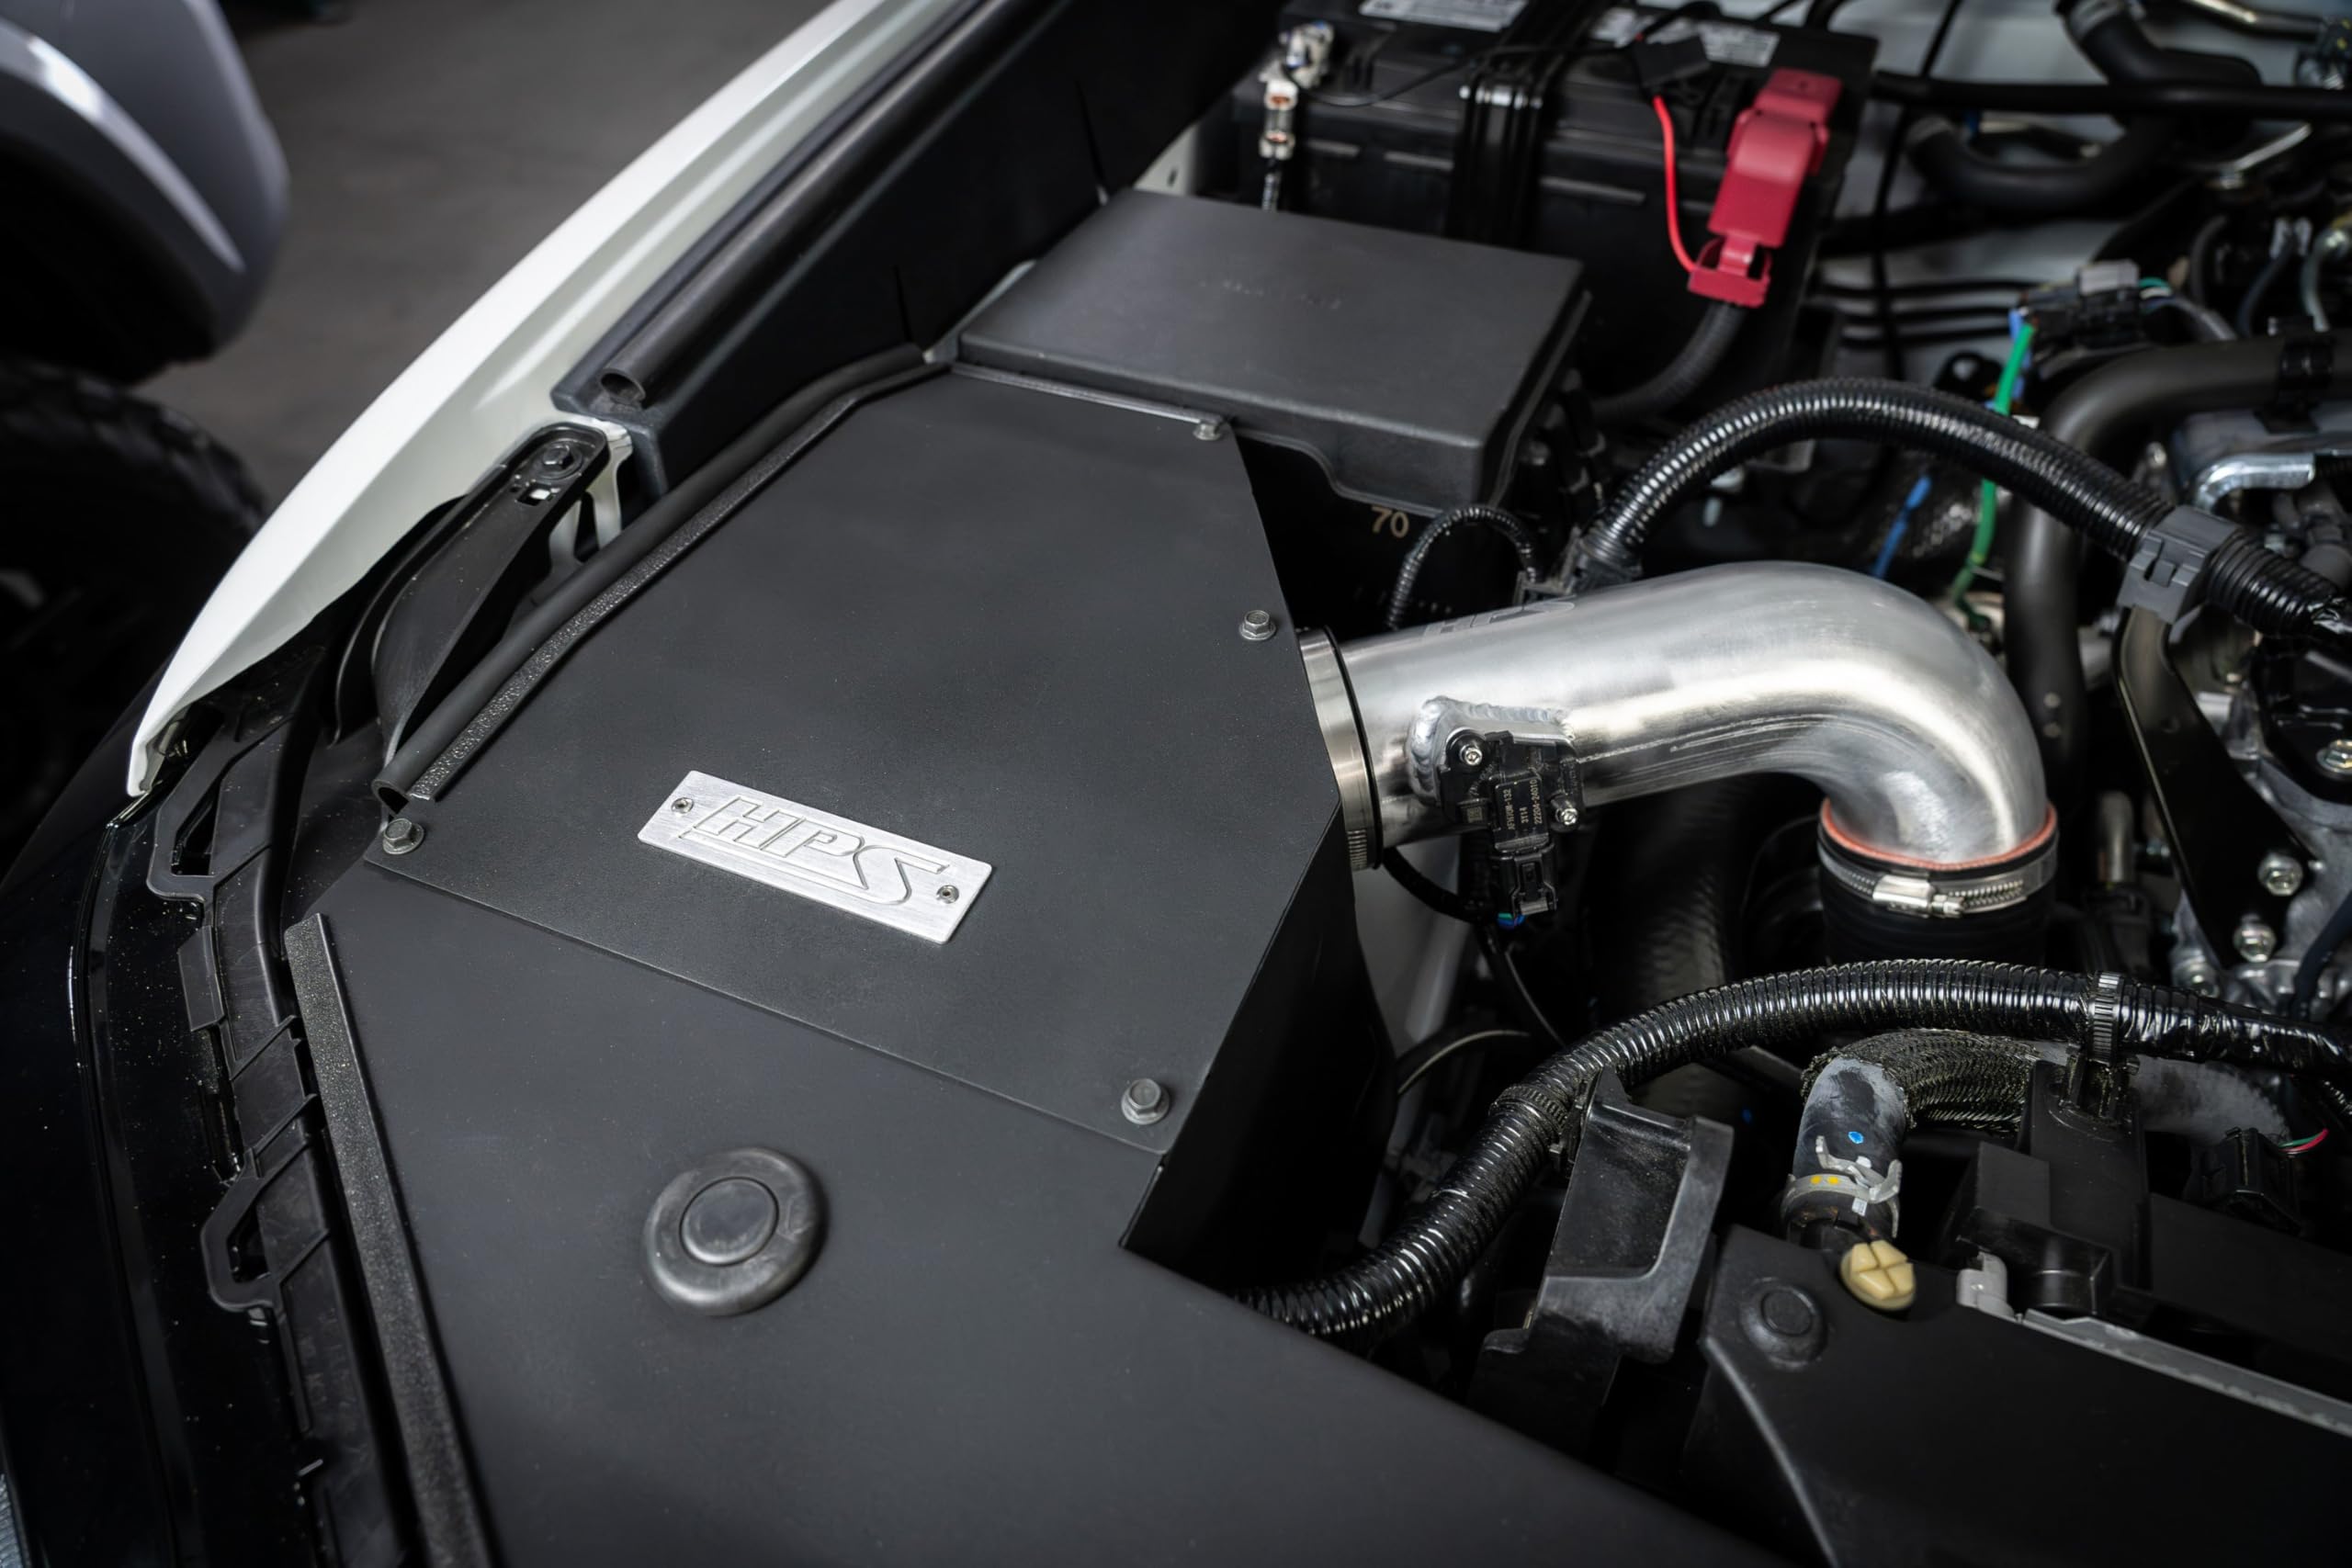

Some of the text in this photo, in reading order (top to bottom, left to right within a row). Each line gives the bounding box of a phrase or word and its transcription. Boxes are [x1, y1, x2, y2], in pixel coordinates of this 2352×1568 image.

[1371, 506, 1409, 538] 70
[1529, 779, 1543, 825] 22204-24010
[678, 795, 950, 905] HPS
